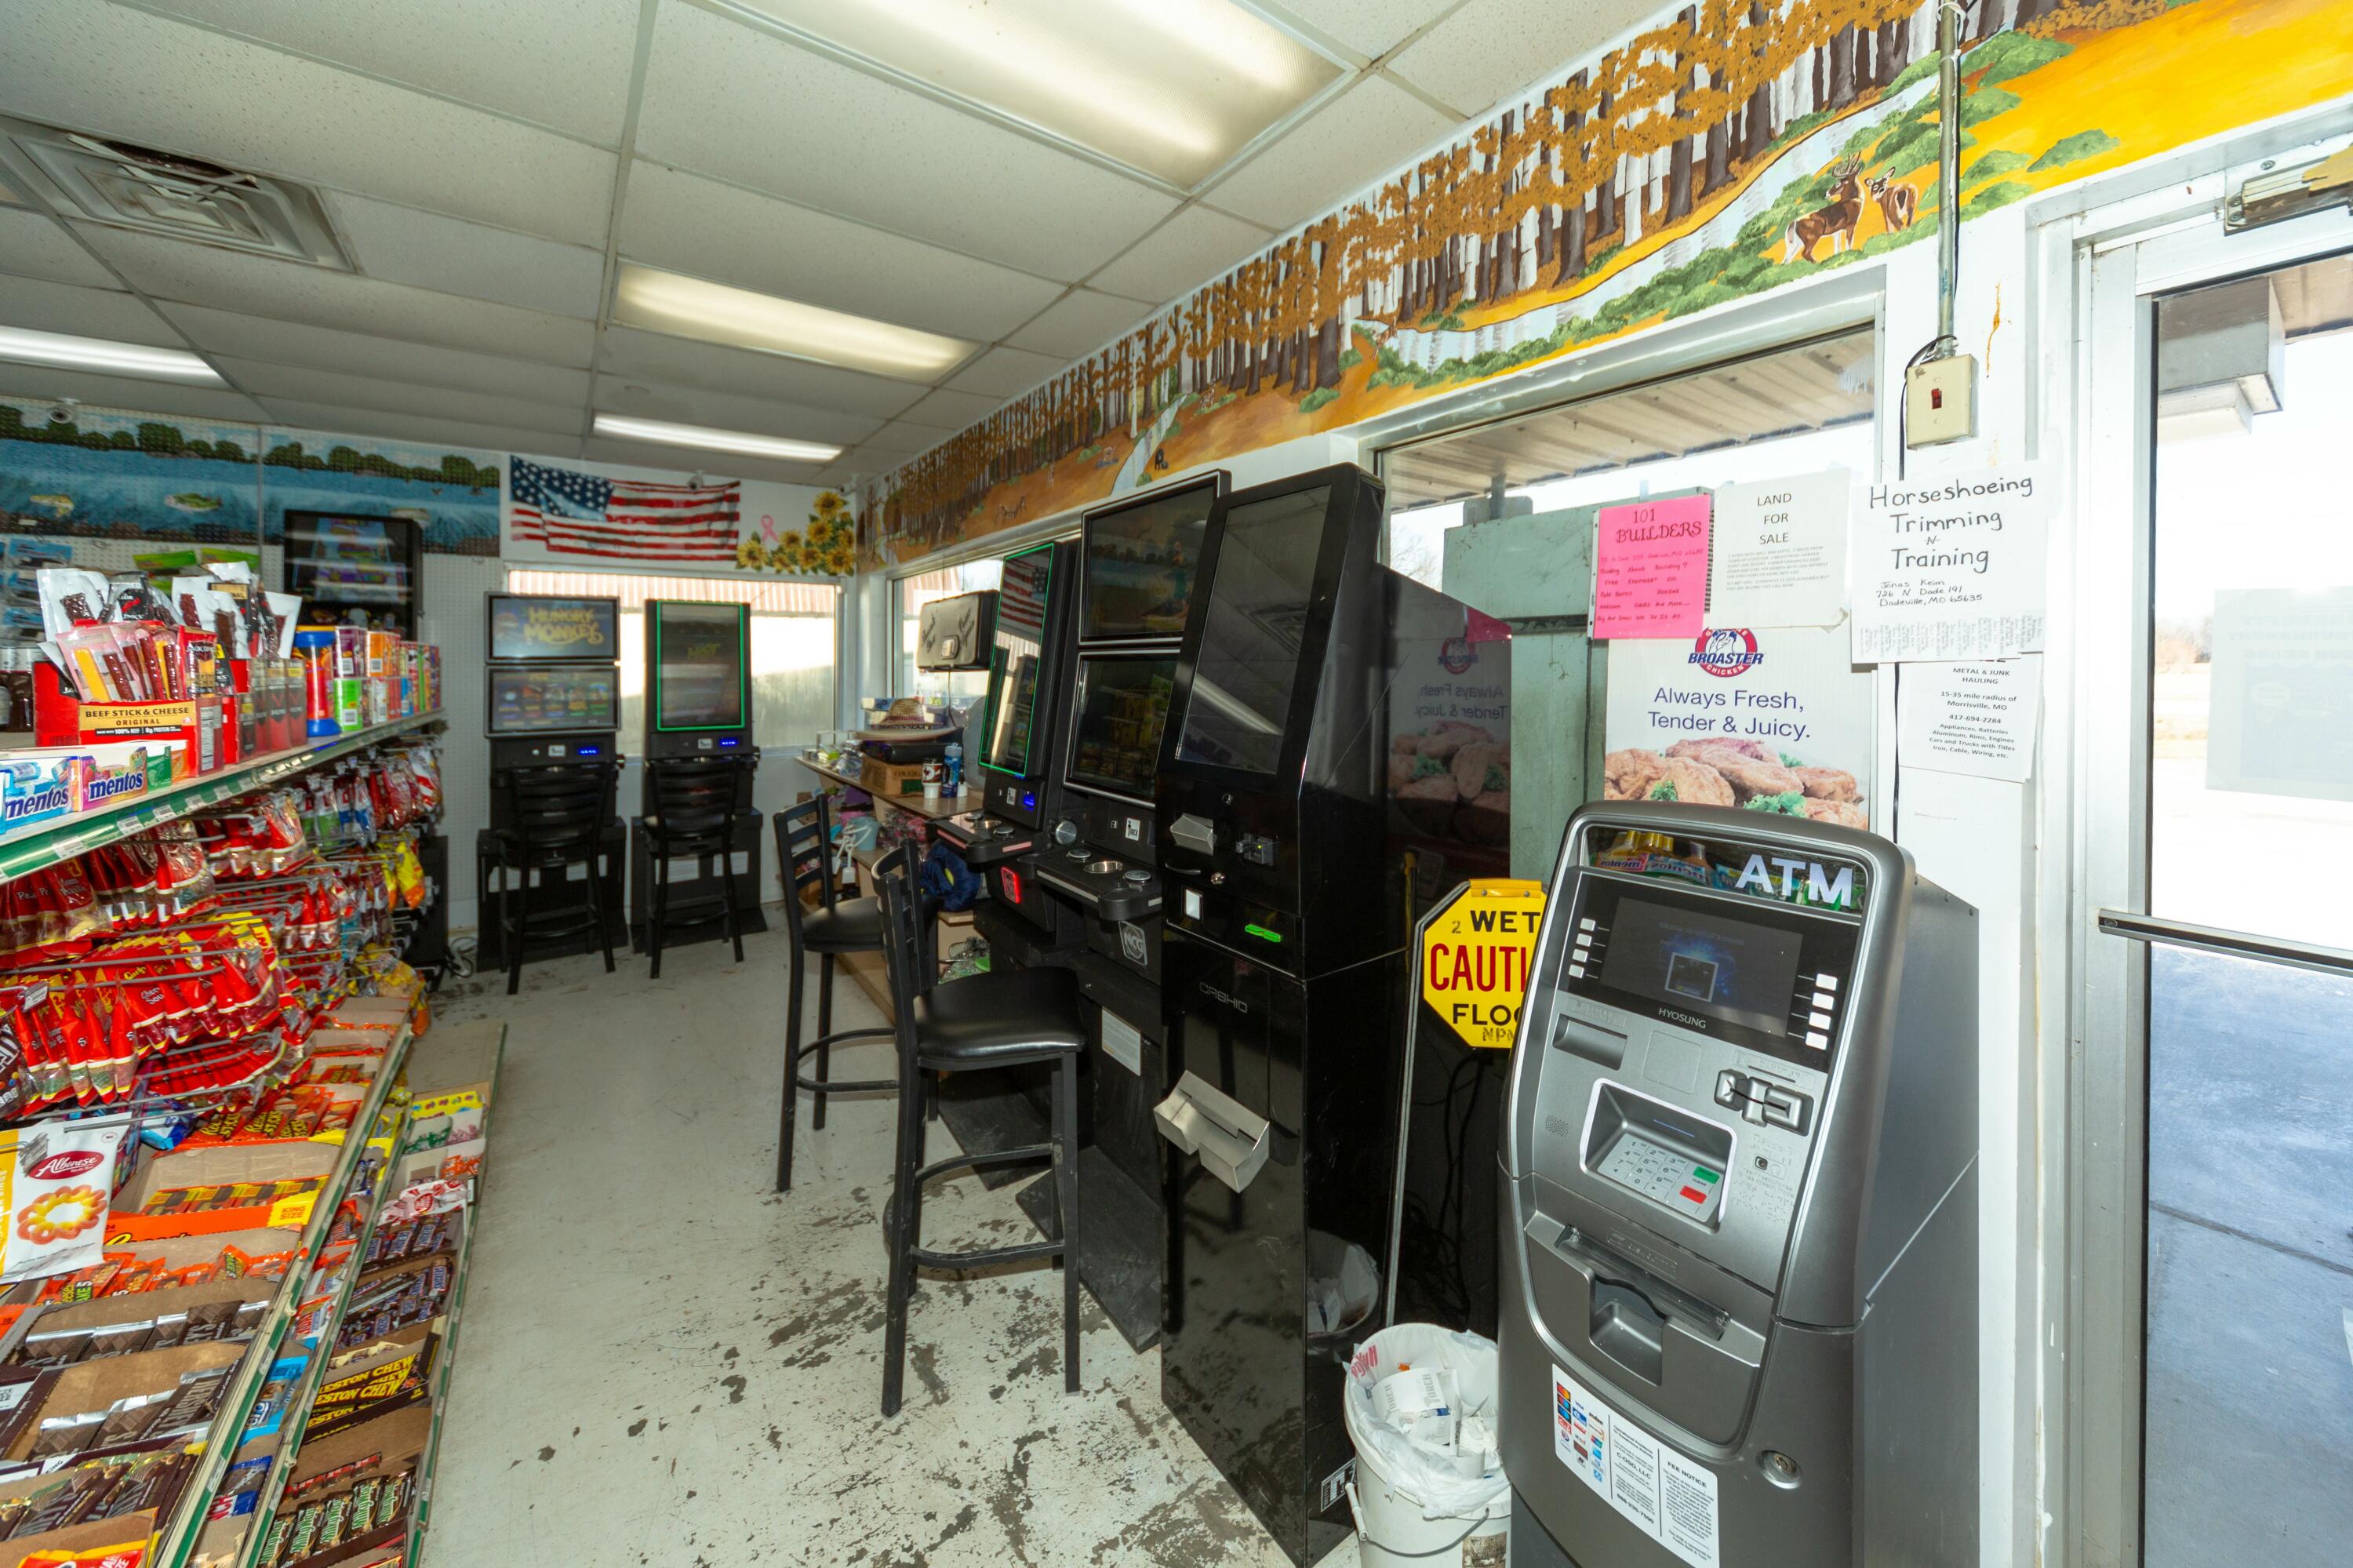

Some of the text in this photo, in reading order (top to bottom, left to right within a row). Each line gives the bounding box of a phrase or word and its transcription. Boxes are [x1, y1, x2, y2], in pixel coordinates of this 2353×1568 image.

[1757, 493, 1792, 507] LAND
[1870, 478, 2033, 509] Horseshoeing
[1634, 509, 1655, 523] 101
[1764, 513, 1788, 525] FOR
[1889, 511, 2002, 533] Trimming
[1616, 522, 1702, 543] BUILDERS
[1759, 533, 1788, 545] SALE
[1891, 548, 1989, 573] Training
[1879, 598, 1926, 607] Dadeville,
[1950, 594, 1983, 602] 65635
[1688, 653, 1764, 664] BROASTER
[1707, 664, 1744, 675] CHICKEN
[1654, 687, 1804, 712] Always Fresh,
[1947, 700, 1991, 710] Morrisville,
[1648, 711, 1811, 742] Tender & Juicy.
[1940, 723, 1977, 732] Appliances,
[1949, 715, 2002, 724] 417-694-2284
[89, 773, 143, 799] mentos
[5, 786, 69, 818] mentos
[1735, 853, 1854, 907] ATM
[1470, 910, 1540, 933] WET
[1124, 933, 1144, 952] NCG
[1431, 943, 1529, 992] CAUTI
[141, 988, 160, 999] Cher
[1199, 981, 1247, 1013] CASHIO
[1453, 1003, 1522, 1026] FLO
[1658, 1007, 1707, 1029] HYOSUNG
[34, 1155, 97, 1177] Albanese
[279, 1212, 304, 1221] SIZE
[75, 1286, 92, 1301] AKE
[319, 1353, 417, 1395] LESTON CHEW
[315, 1378, 405, 1405] ESTON CHEW
[307, 1407, 355, 1428] ESTON
[1638, 1467, 1651, 1480] LLC
[1667, 1461, 1707, 1489] FEE NOTICE
